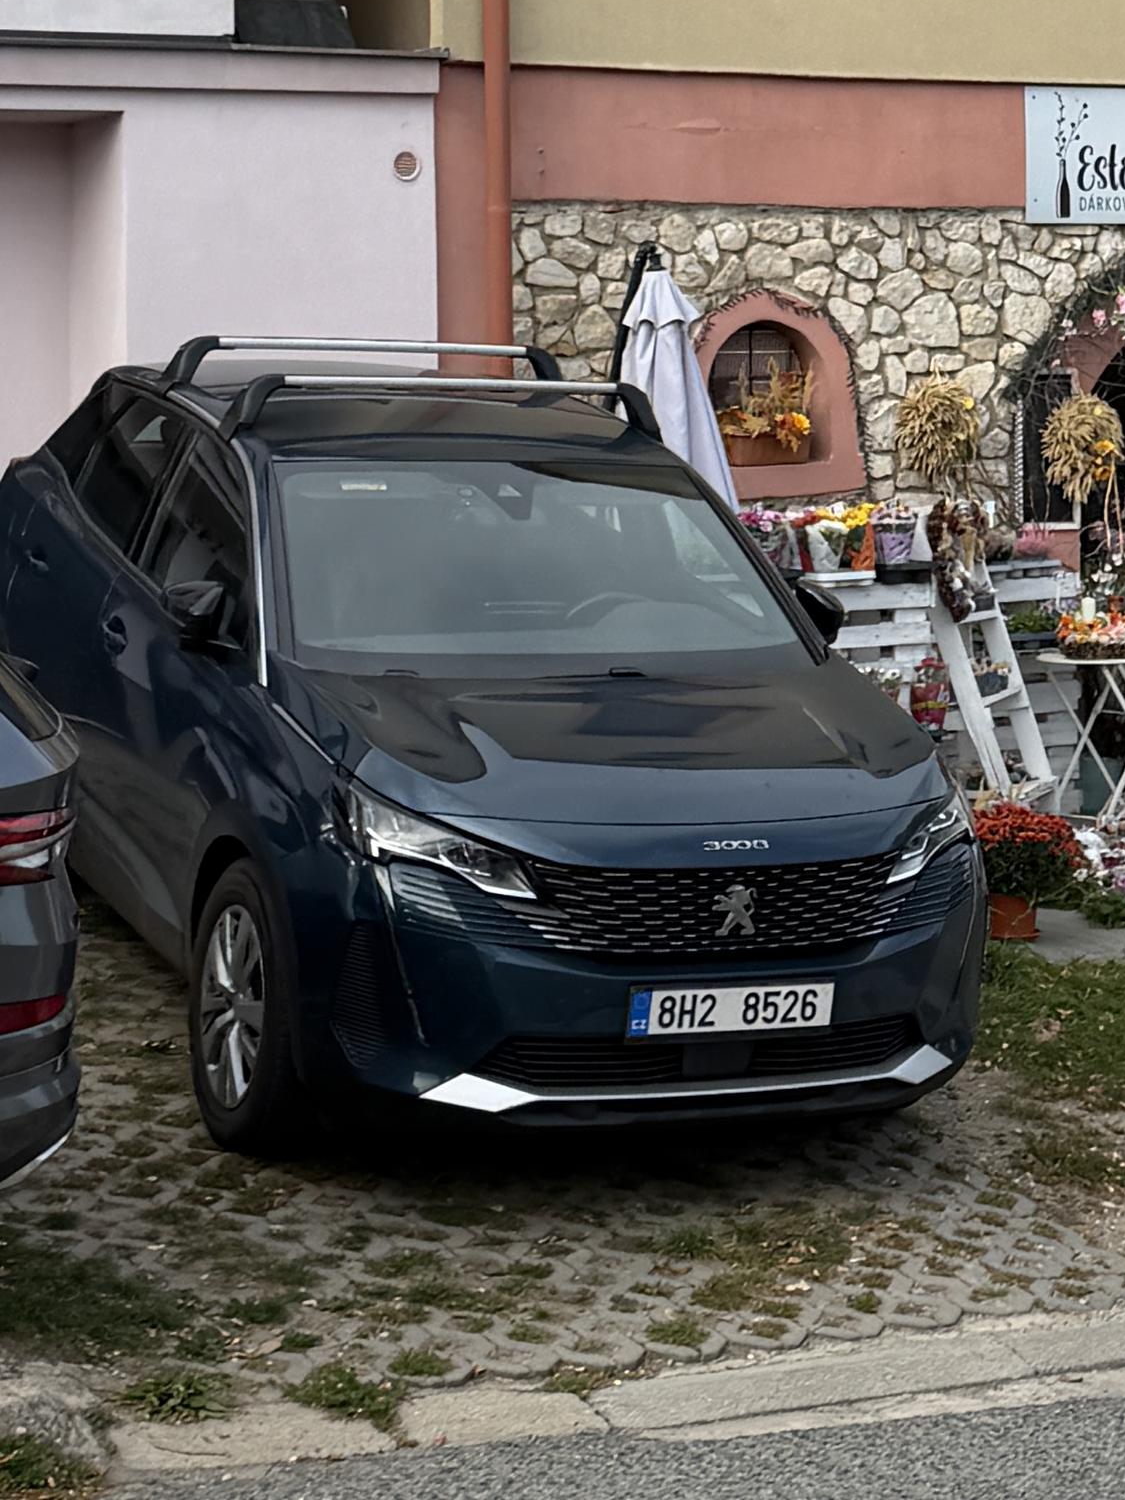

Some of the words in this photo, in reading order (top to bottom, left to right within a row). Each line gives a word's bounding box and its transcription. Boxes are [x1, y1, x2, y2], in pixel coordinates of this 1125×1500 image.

[703, 840, 769, 850] 3008
[631, 1019, 647, 1030] CZ
[658, 994, 717, 1029] 8H2
[742, 989, 819, 1026] 8526
